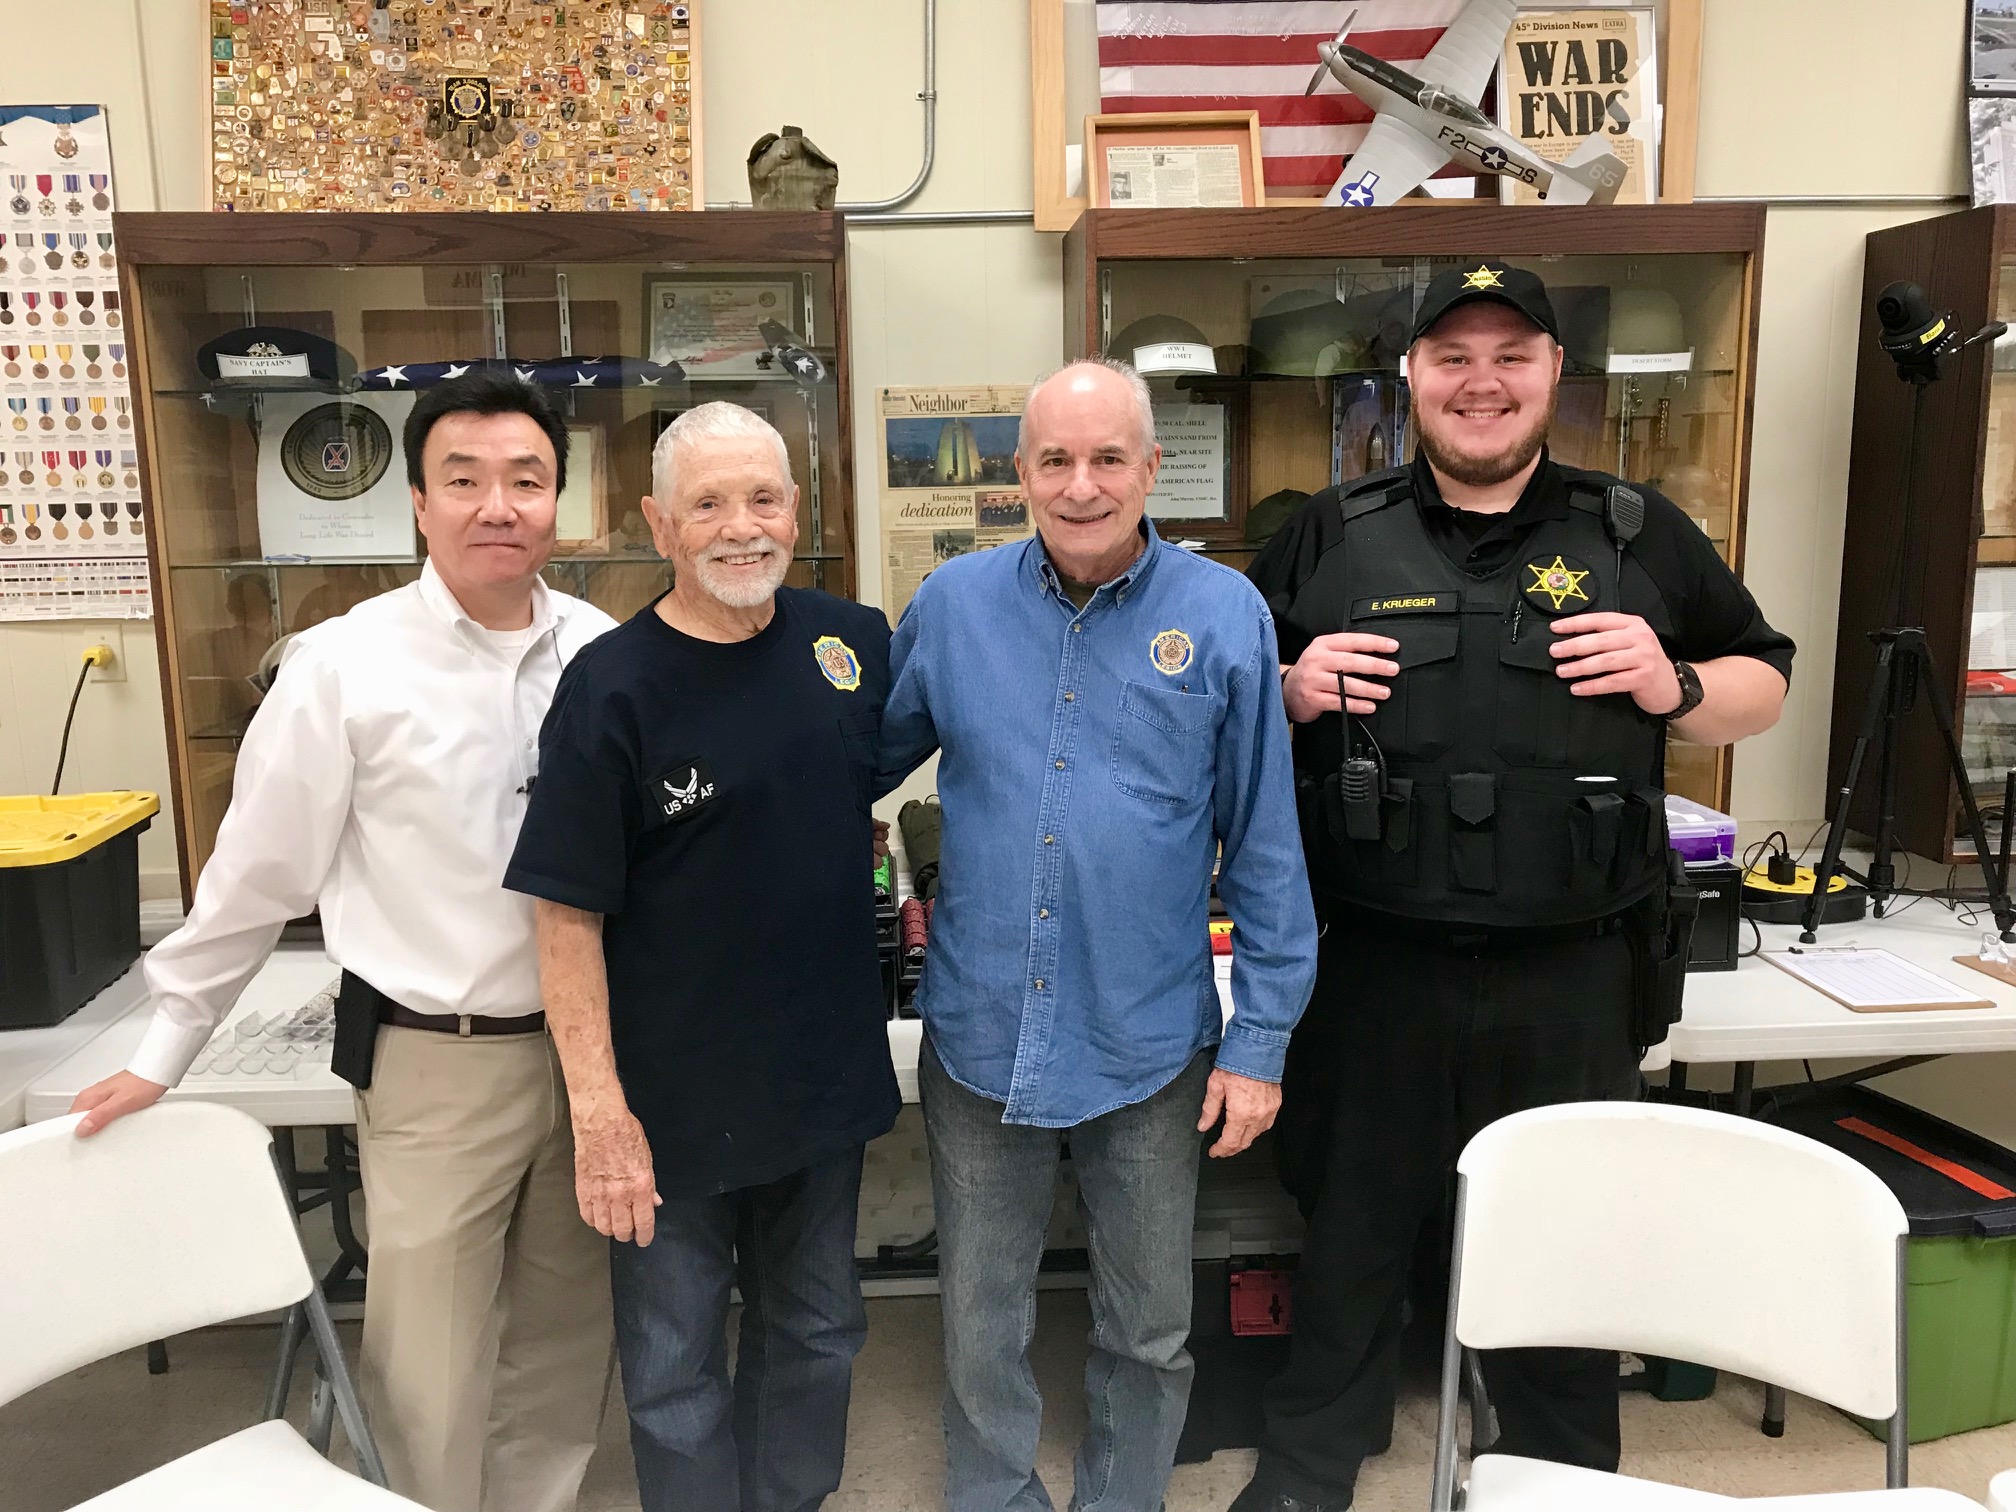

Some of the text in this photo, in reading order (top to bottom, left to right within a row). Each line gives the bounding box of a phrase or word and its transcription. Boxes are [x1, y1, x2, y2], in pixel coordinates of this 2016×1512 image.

[1533, 21, 1570, 31] Division
[1572, 21, 1599, 30] News
[1604, 20, 1624, 28] EXTRA
[1516, 38, 1629, 87] WAR
[1518, 89, 1631, 139] ENDS
[1437, 124, 1466, 150] F2
[1549, 141, 1565, 149] Europe
[1588, 163, 1620, 188] 65
[1162, 352, 1192, 360] HELMET
[229, 359, 292, 368] NAVY CAPTAIN'S
[909, 393, 968, 415] Neighbor
[932, 492, 972, 504] Honoring
[298, 512, 332, 521] Dedicated
[900, 502, 974, 518] dedication
[299, 531, 317, 540] Long
[1371, 597, 1436, 611] E. KRUEGER
[663, 782, 715, 816] US AF
